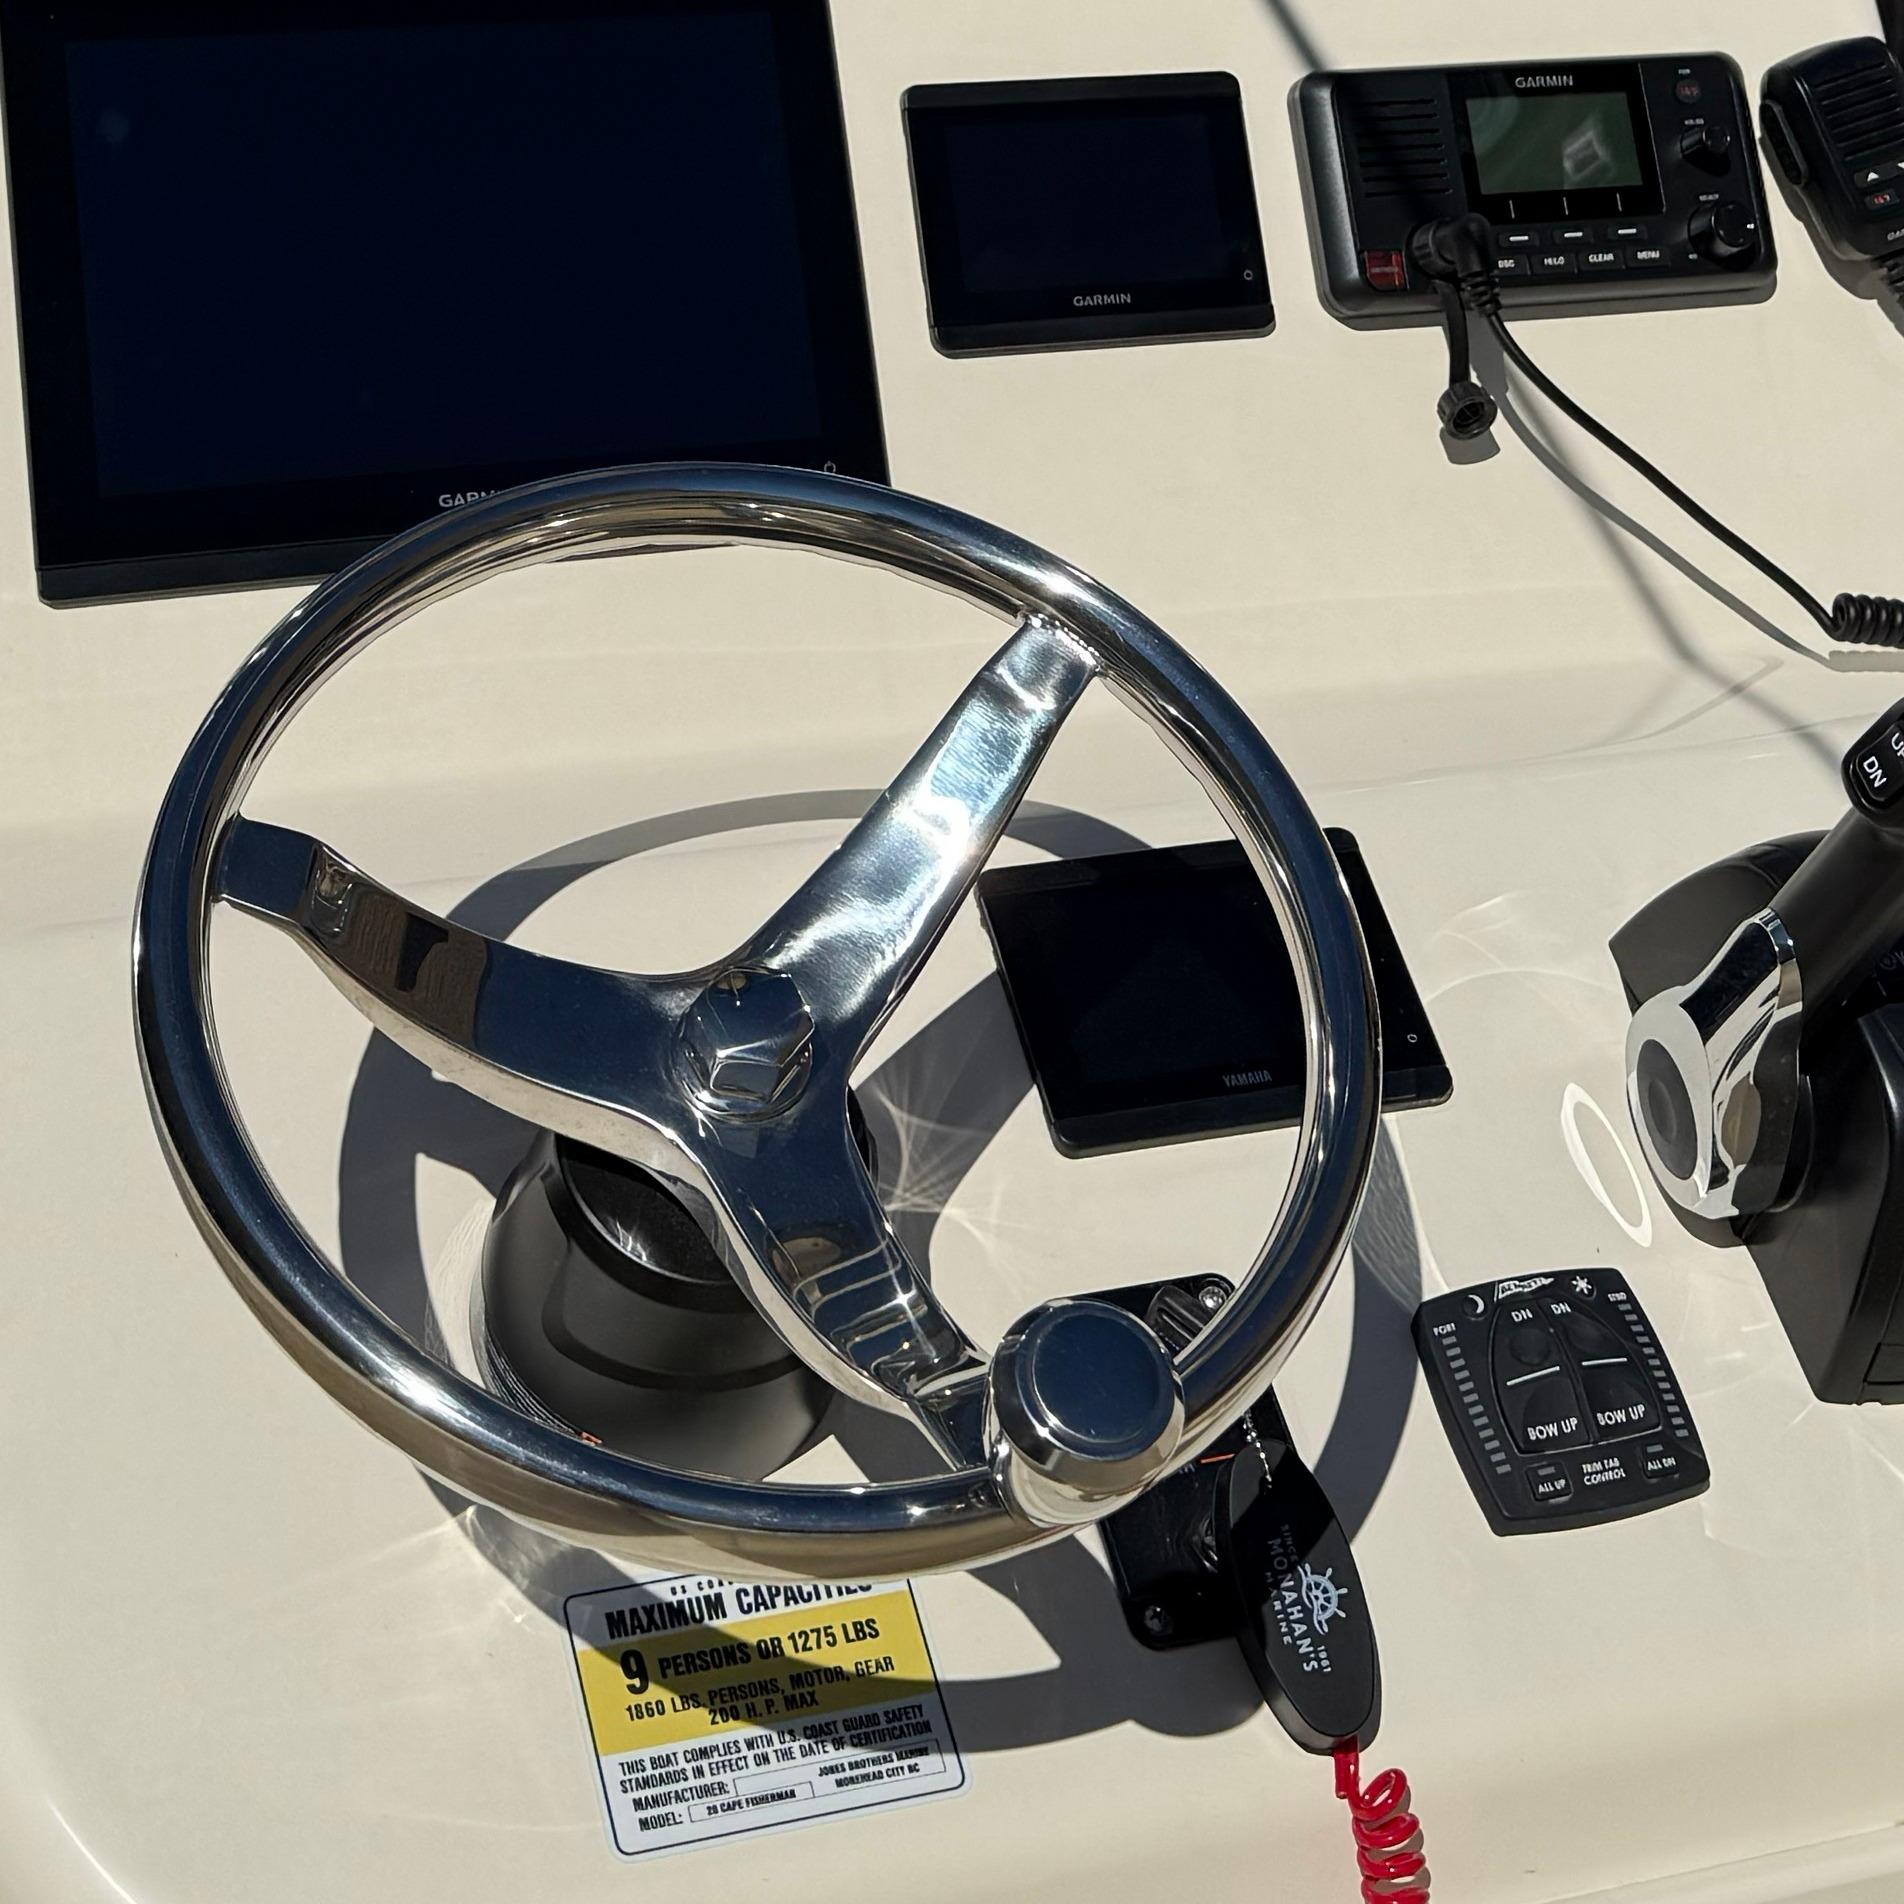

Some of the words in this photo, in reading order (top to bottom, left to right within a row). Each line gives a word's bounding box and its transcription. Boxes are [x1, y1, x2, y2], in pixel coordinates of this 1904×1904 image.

[1515, 74, 1573, 88] GARMIN
[1588, 253, 1615, 263] CLEAR
[1637, 250, 1660, 260] MENU
[1073, 292, 1131, 307] GARMIN
[1863, 755, 1887, 788] DN
[1222, 1070, 1273, 1088] YAMAHA
[1511, 1308, 1533, 1322] DN
[1550, 1301, 1572, 1315] DN
[1596, 1408, 1627, 1426] BOW
[1629, 1404, 1645, 1421] UP
[1527, 1423, 1559, 1441] BOW
[1561, 1417, 1578, 1433] UP
[1583, 1468, 1627, 1486] CONTROL
[1647, 1461, 1662, 1472] ALL
[1538, 1482, 1554, 1494] ALL
[1554, 1479, 1567, 1490] UP
[604, 1592, 728, 1640] MAXIMUM
[1264, 1571, 1293, 1646] MARINE
[1267, 1537, 1319, 1672] MONAHAN'S
[619, 1648, 650, 1696] 9
[657, 1642, 752, 1680] PERSONS
[756, 1636, 786, 1661] OR
[787, 1624, 838, 1654] 1275
[841, 1617, 880, 1644] LBS
[625, 1699, 666, 1722] 1860
[708, 1678, 785, 1707] PERSONS,
[789, 1665, 850, 1692] MOTOR,
[854, 1655, 895, 1679] GEAR
[708, 1704, 741, 1726] 200
[783, 1690, 820, 1712] MAX
[618, 1758, 647, 1777] THIS
[649, 1751, 681, 1772] BOAT
[683, 1739, 742, 1764] COMPLIES
[743, 1731, 775, 1752] WITH
[777, 1727, 801, 1745] U.S.
[802, 1720, 840, 1741] COAST
[842, 1712, 881, 1734] GUARD
[883, 1703, 924, 1725] SAFETY
[619, 1767, 690, 1794] STANDARDS
[691, 1764, 706, 1780] IN
[708, 1758, 751, 1777] EFFECT
[753, 1752, 772, 1768] ON
[773, 1747, 797, 1764] THE
[799, 1739, 830, 1759] DATE
[831, 1736, 846, 1752] OF
[848, 1719, 933, 1749] CERTIFICATION
[847, 1752, 895, 1772] BROTHERS
[834, 1770, 884, 1789] MOREHEAD
[885, 1765, 906, 1779] CITY
[632, 1780, 731, 1813] MANUFACTURER:
[719, 1799, 745, 1813] CAPE
[745, 1789, 797, 1809] FISHERMAN
[637, 1811, 684, 1833] MODEL:
